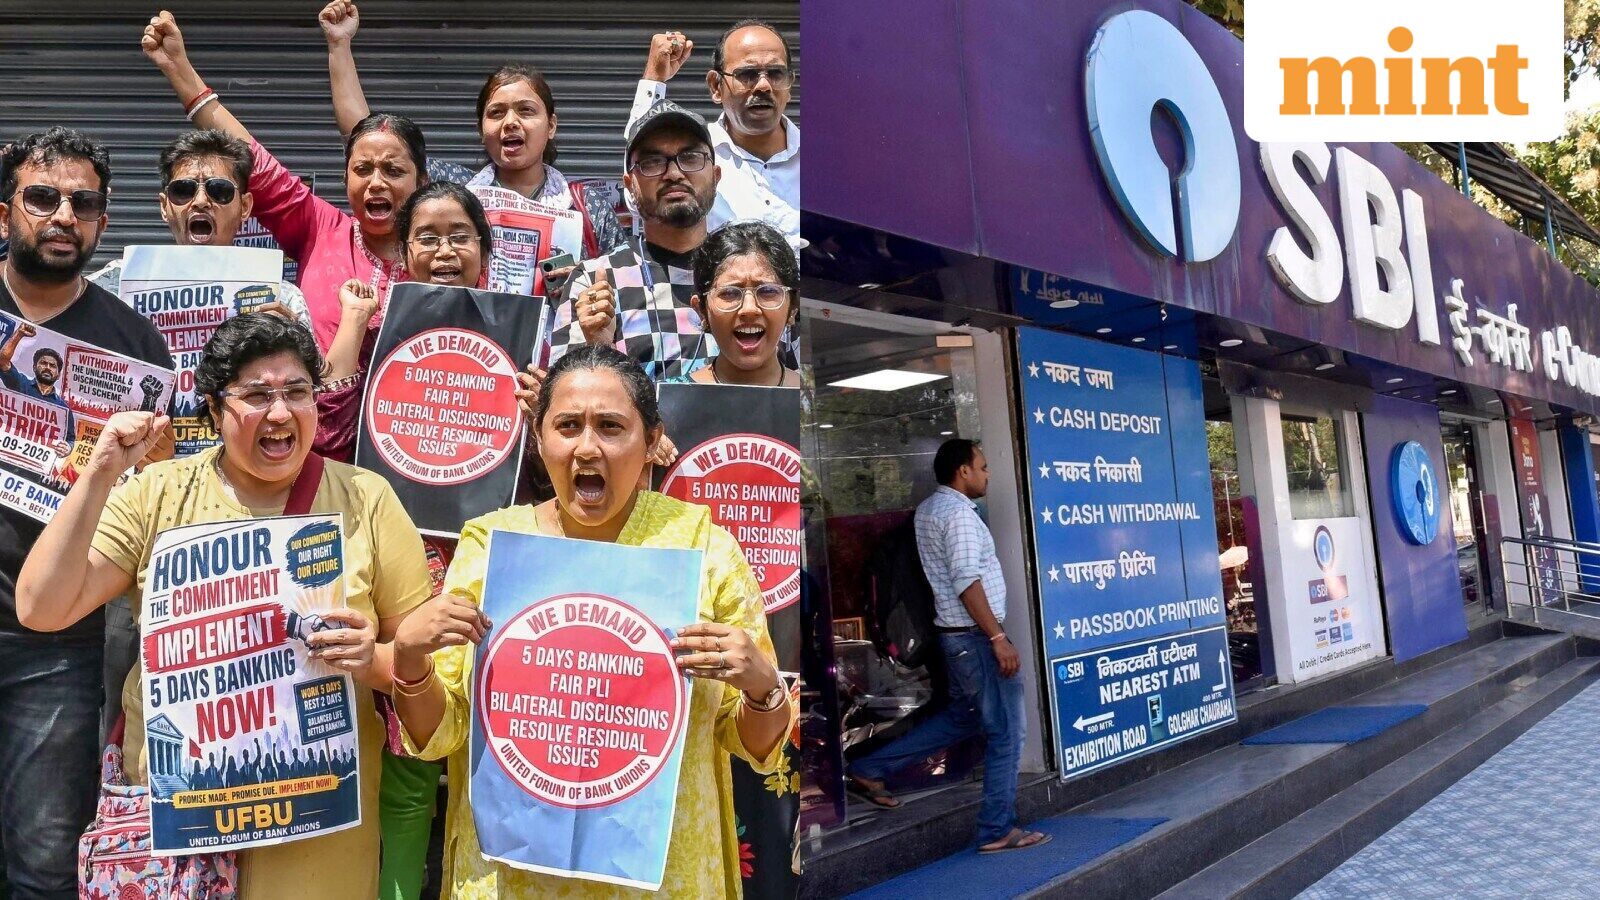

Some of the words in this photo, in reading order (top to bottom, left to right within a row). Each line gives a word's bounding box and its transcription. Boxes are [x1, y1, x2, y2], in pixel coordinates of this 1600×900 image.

[495, 199, 519, 210] STRIKE
[517, 232, 538, 245] STRIKE
[1259, 141, 1441, 346] SBI
[133, 285, 225, 314] HONOUR
[149, 306, 229, 328] COMMITMENT
[162, 328, 216, 351] LEMEN
[409, 337, 434, 359] WE
[438, 335, 500, 369] DEMAND
[72, 363, 84, 374] THE
[85, 366, 127, 385] UNILATERAL
[128, 377, 134, 386] &
[79, 353, 129, 374] WITHDRAW
[1043, 361, 1081, 387] नकद
[1084, 368, 1115, 391] जमा
[73, 374, 132, 395] DISCRIMINATORY
[404, 366, 413, 381] 5
[414, 367, 444, 386] DAYS
[446, 372, 496, 392] BANKING
[79, 384, 91, 395] PLI
[91, 389, 123, 403] SCHEME
[424, 387, 451, 405] FAIR
[451, 392, 470, 408] PLI
[21, 401, 58, 426] INDIA
[376, 399, 435, 422] BILATERAL
[438, 410, 512, 432] DISCUSSIONS
[1050, 406, 1096, 430] CASH
[1099, 411, 1162, 435] DEPOSIT
[390, 419, 439, 439] RESOLVE
[442, 427, 495, 447] RESIDUAL
[381, 437, 403, 464] UNITED
[402, 459, 429, 477] FORUM
[430, 467, 442, 479] OF
[443, 465, 467, 479] BANK
[467, 451, 497, 473] UNIONS
[418, 439, 458, 457] ISSUES
[692, 446, 723, 473] WE
[725, 442, 800, 478] DEMAND
[1052, 461, 1092, 483] नकद
[1093, 455, 1143, 484] निकासी
[4, 477, 24, 494] OF
[26, 485, 62, 511] BANK
[692, 481, 701, 498] 5
[704, 482, 739, 501] DAYS
[741, 484, 800, 504] BANKING
[28, 502, 46, 516] BEFI
[718, 504, 748, 522] FAIR
[751, 505, 772, 523] PLI
[1057, 504, 1104, 526] CASH
[1108, 502, 1200, 524] WITHDRAWAL
[291, 539, 302, 550] OUR
[302, 530, 337, 547] COMMITMENT
[152, 527, 273, 593] HONOUR
[298, 549, 312, 564] OUR
[312, 544, 333, 560] RIGHT
[297, 565, 311, 580] OUR
[312, 557, 339, 576] FUTURE
[1063, 558, 1116, 590] पासबुक
[150, 599, 169, 619] THE
[172, 568, 281, 618] COMMITMENT
[777, 573, 800, 600] UNION
[526, 607, 559, 635] WE
[564, 603, 648, 645] DEMAND
[1070, 607, 1157, 640] PASSBOOK
[1158, 596, 1220, 623] PRINTING
[156, 609, 275, 669] IMPLEMENT
[522, 645, 533, 665] 5
[535, 646, 575, 669] DAYS
[577, 652, 644, 677] BANKING
[1160, 641, 1198, 666] एटीएम
[1306, 657, 1317, 668] Debit
[1319, 653, 1333, 664] Credit
[1333, 649, 1345, 659] Cards
[150, 678, 162, 708] 5
[167, 668, 210, 705] DAYS
[214, 647, 296, 695] BANKING
[1067, 661, 1085, 679] SBI
[301, 685, 320, 699] WORK
[320, 684, 325, 695] 5
[326, 680, 342, 693] DAYS
[550, 673, 582, 696] FAIR
[586, 678, 611, 699] PLI
[1099, 670, 1169, 705] NEAREST
[1172, 662, 1200, 686] ATM
[1211, 691, 1223, 699] MTR.
[304, 697, 320, 711] REST
[320, 696, 326, 707] 2
[326, 692, 342, 705] DAYS
[490, 691, 566, 718] BILATERAL
[570, 701, 669, 731] DISCUSSIONS
[156, 721, 171, 732] BANK
[195, 685, 278, 745] NOW!
[307, 713, 332, 727] BALANCED
[333, 710, 343, 720] LIFE
[307, 724, 325, 737] BETTER
[325, 719, 347, 732] BANKING
[1087, 725, 1099, 735] 500
[1099, 719, 1115, 732] MTR.
[1167, 709, 1200, 736] GOLGHAR
[1199, 697, 1233, 726] CHAURAHA
[509, 718, 573, 744] RESOLVE
[577, 726, 648, 753] RESIDUAL
[1065, 733, 1122, 771] EXHIBITION
[1122, 724, 1147, 751] ROAD
[547, 743, 600, 769] ISSUES
[500, 743, 529, 779] UNITED
[529, 773, 566, 799] FORUM
[568, 785, 582, 800] OF
[585, 783, 614, 800] BANK
[616, 758, 651, 791] UNIONS
[178, 793, 207, 805] PROMISE
[208, 790, 230, 802] MADE.
[231, 786, 261, 801] PROMISE
[262, 785, 278, 797] DUE.
[278, 781, 315, 794] IMPLEMENT
[315, 776, 333, 788] NOW!
[215, 800, 293, 834] UFBU
[189, 833, 220, 847] UNITED
[221, 830, 250, 844] FORUM
[252, 829, 264, 839] OF
[265, 826, 288, 839] BANK
[290, 821, 321, 835] UNIONS
